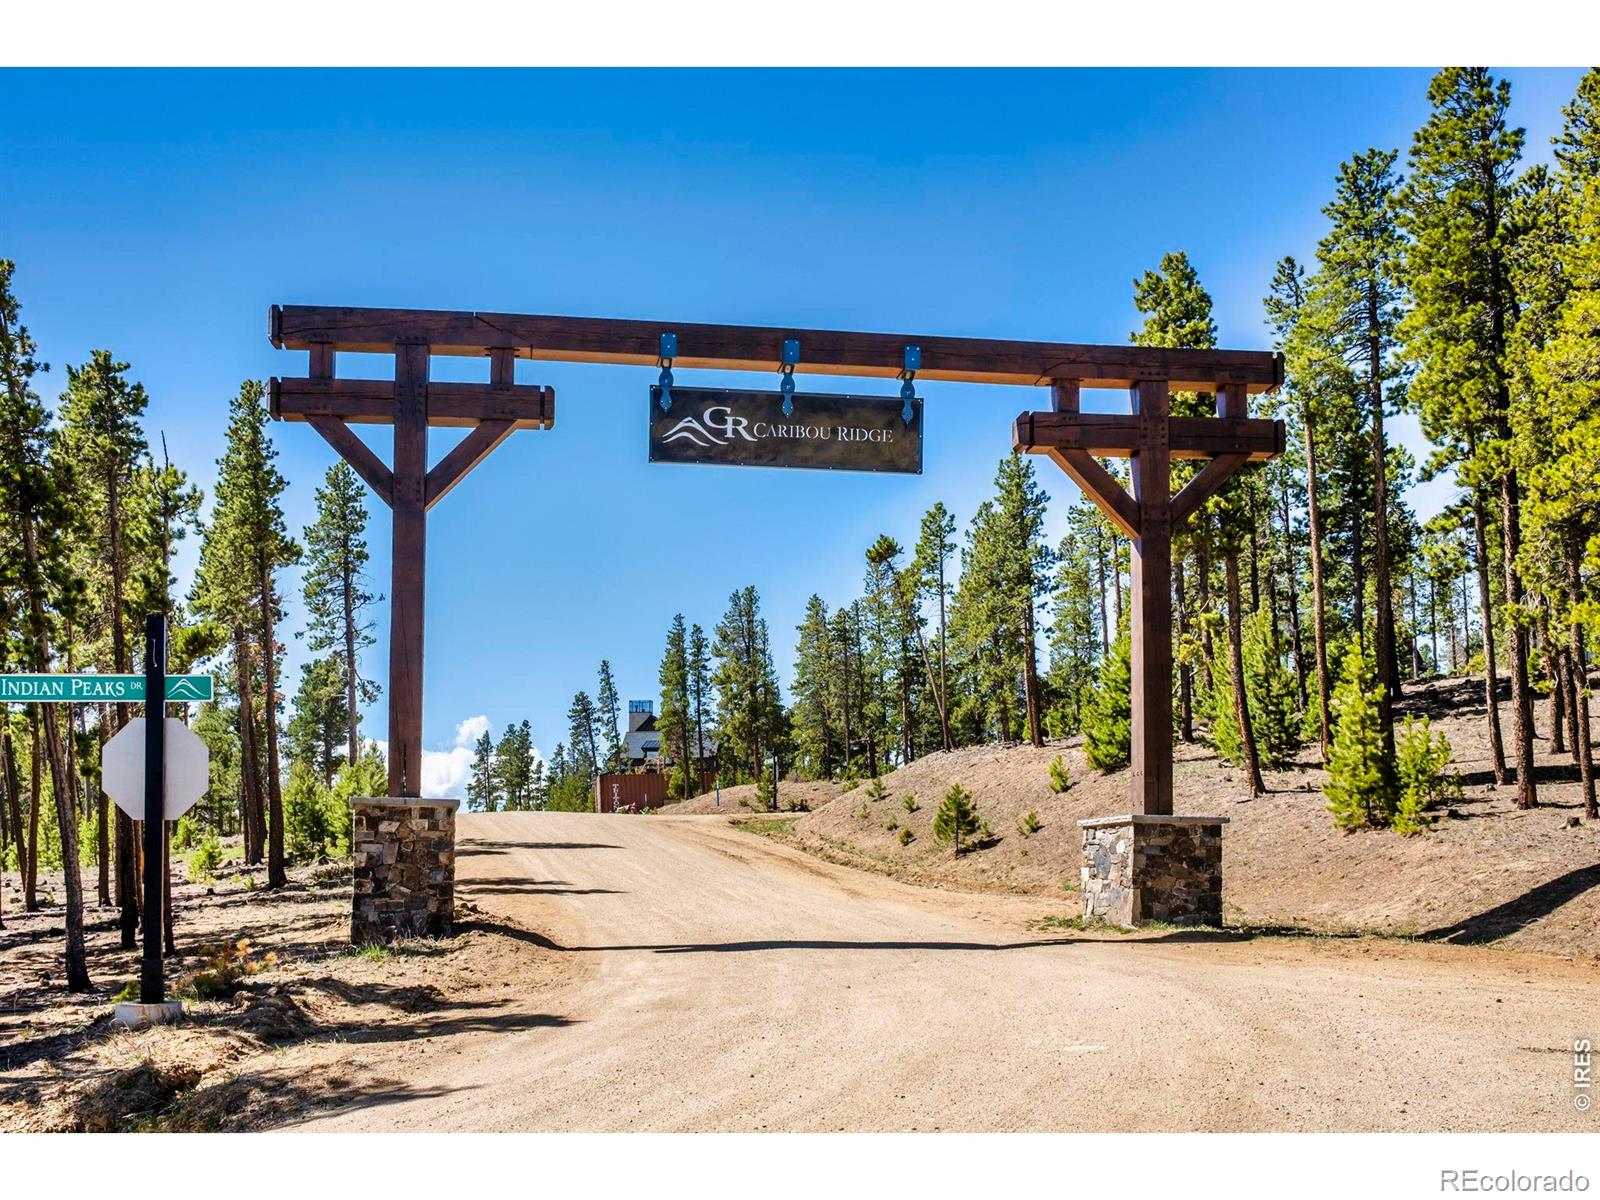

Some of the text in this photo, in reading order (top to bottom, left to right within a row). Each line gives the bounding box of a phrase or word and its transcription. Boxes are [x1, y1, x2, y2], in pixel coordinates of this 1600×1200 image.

[753, 422, 893, 443] CARIBOU RIDGE
[1, 678, 143, 698] INDIAN PEAKS DR
